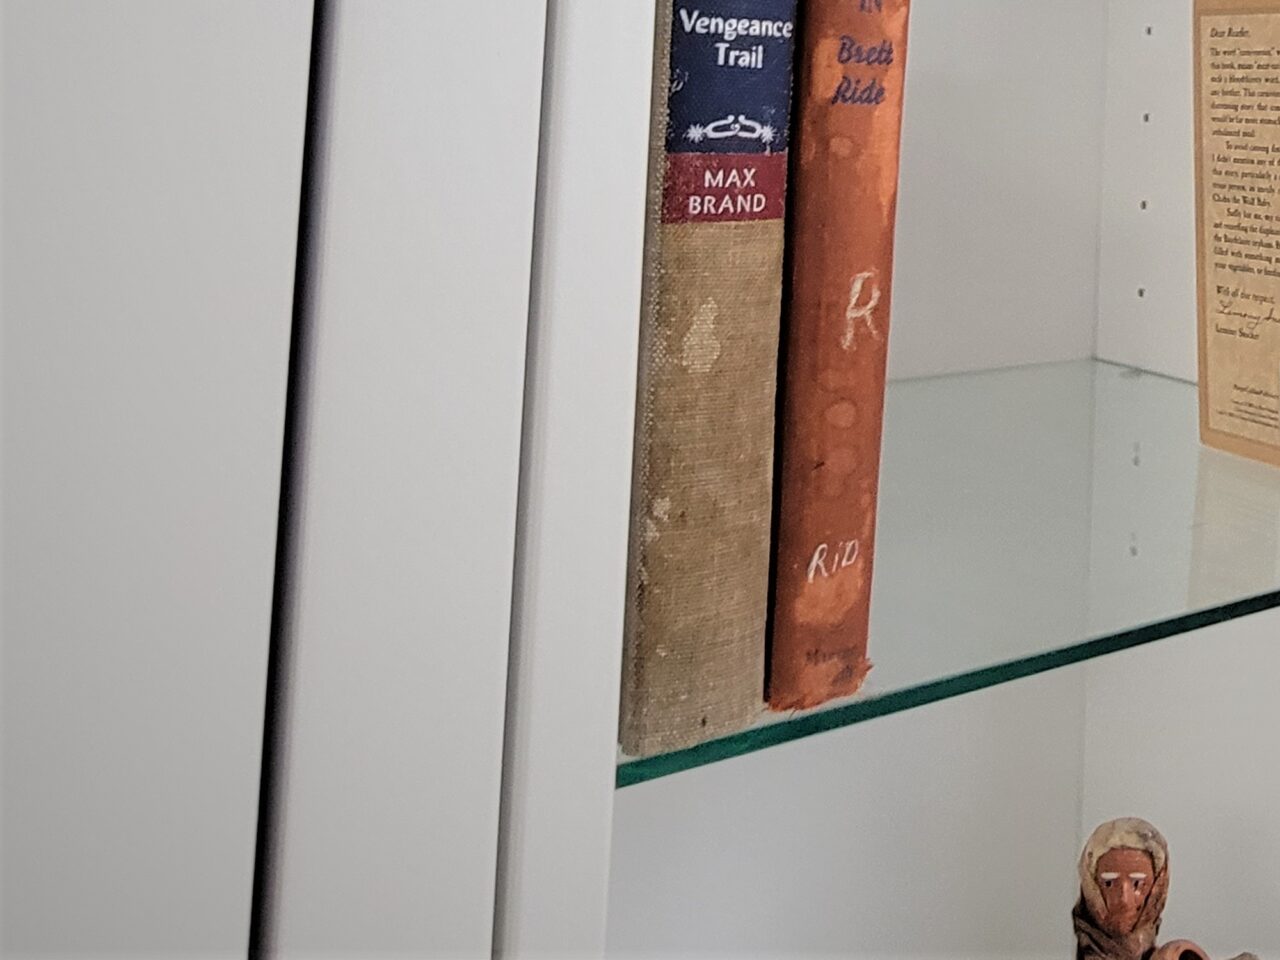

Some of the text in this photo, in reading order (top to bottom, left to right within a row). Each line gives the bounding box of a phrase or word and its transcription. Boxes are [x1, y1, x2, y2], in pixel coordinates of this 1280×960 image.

[679, 8, 794, 40] Vengeance
[714, 43, 765, 70] Trail
[837, 36, 894, 66] Brett
[704, 168, 757, 189] MAX
[688, 193, 766, 215] BRAND
